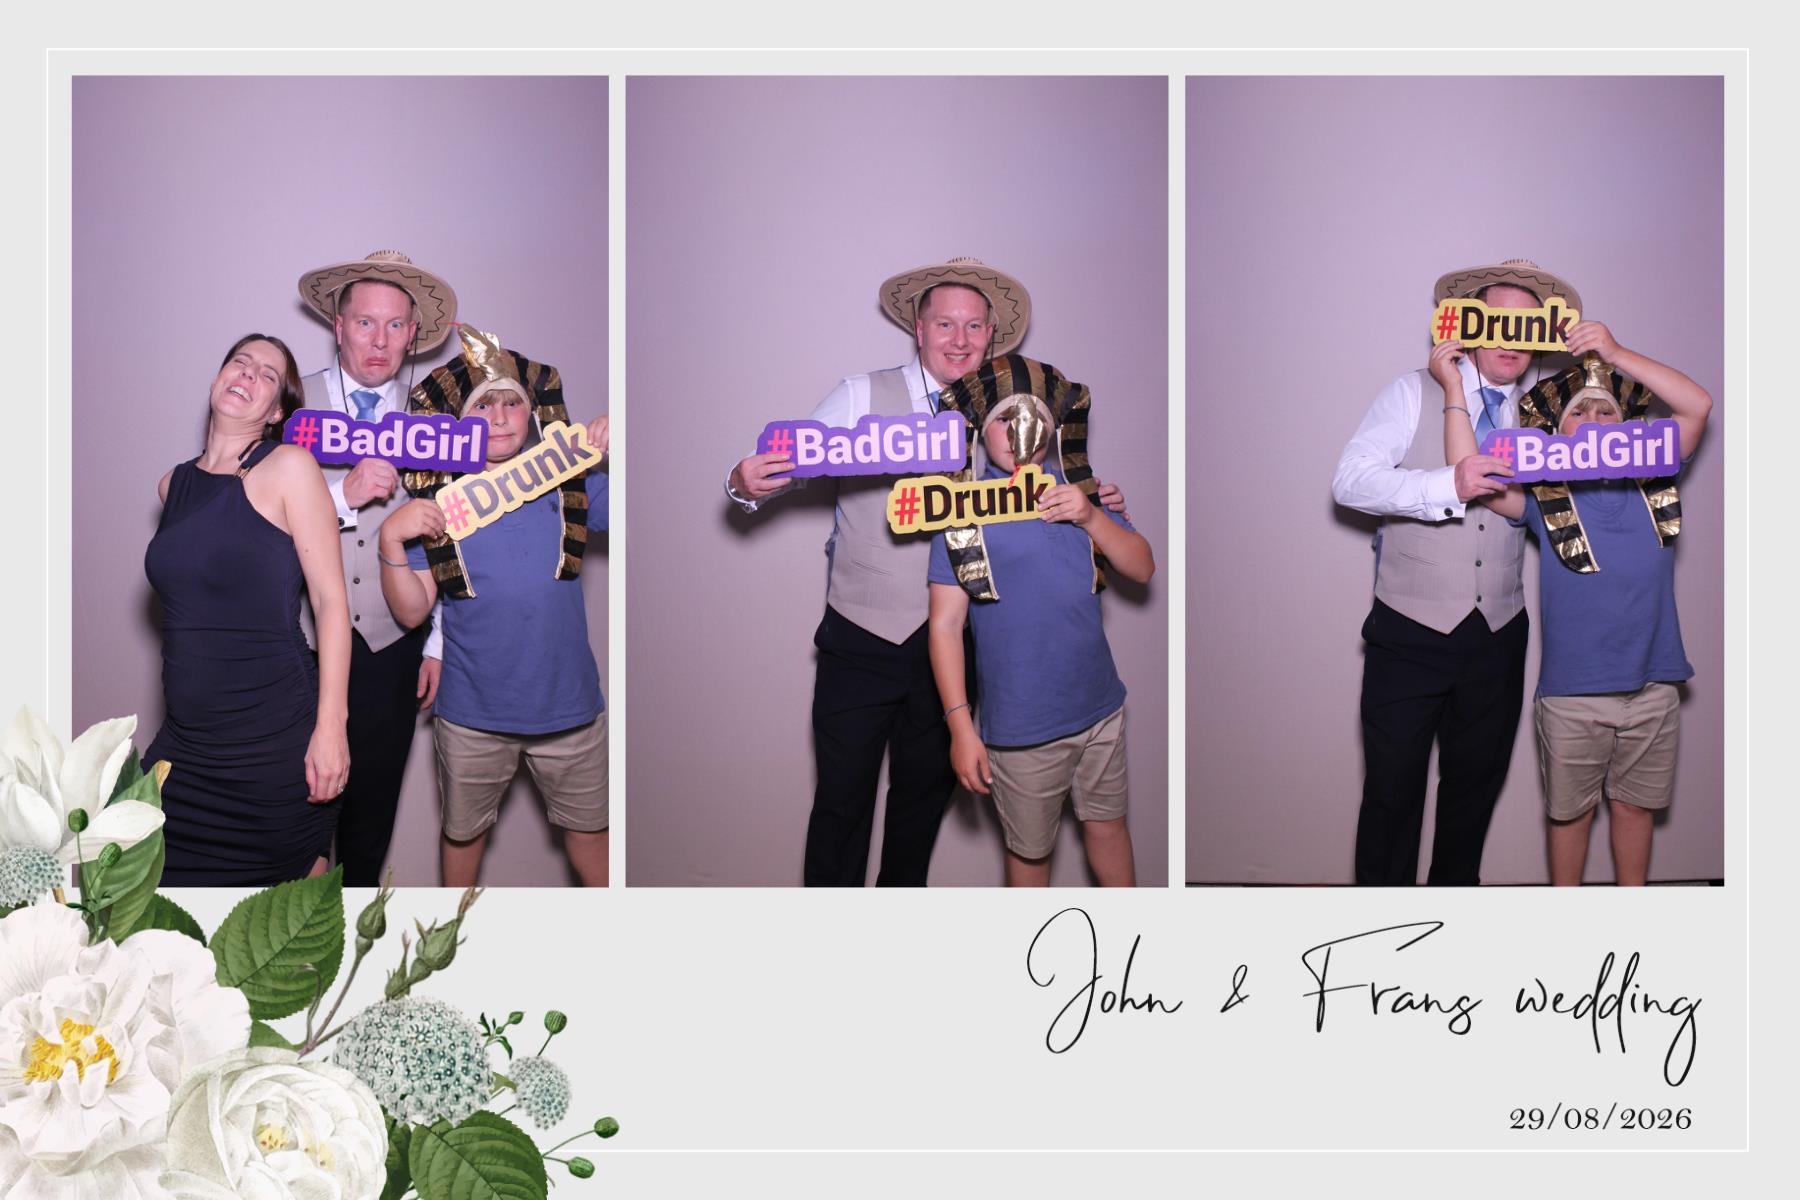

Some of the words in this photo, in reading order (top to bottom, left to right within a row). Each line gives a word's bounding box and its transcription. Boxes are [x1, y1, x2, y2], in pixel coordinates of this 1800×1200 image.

[1436, 305, 1572, 343] #Drunk
[292, 415, 482, 463] #BadGirl
[767, 419, 960, 466] #BadGirl
[1489, 426, 1674, 472] #BadGirl
[442, 428, 592, 532] #Drunk
[894, 472, 1049, 527] #Drunk
